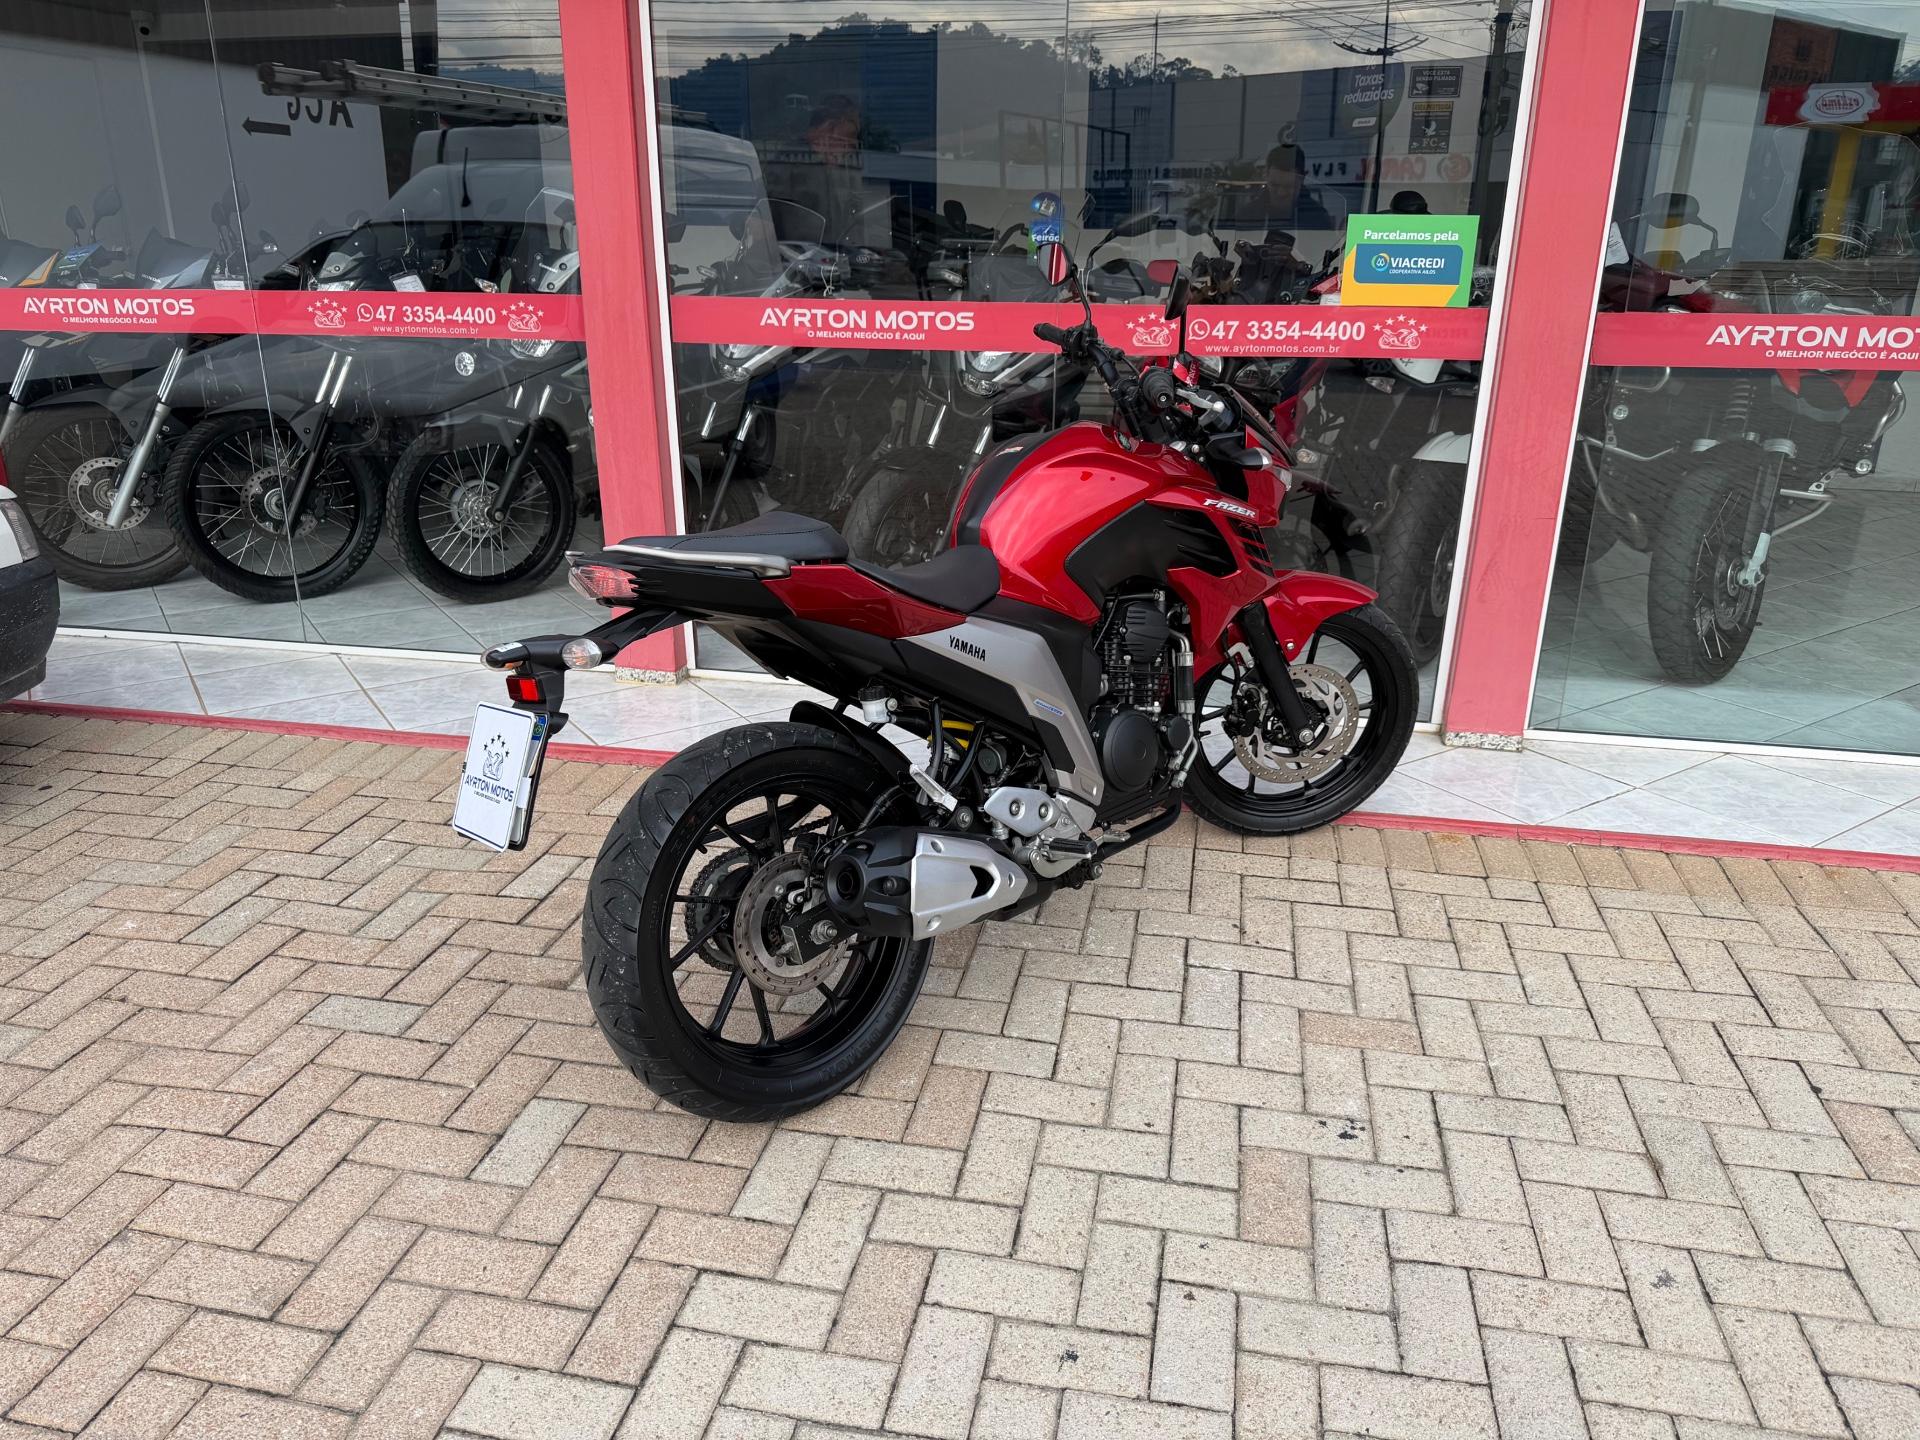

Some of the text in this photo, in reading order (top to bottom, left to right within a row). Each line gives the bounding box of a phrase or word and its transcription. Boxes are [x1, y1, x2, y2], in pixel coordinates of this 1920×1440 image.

[1354, 73, 1385, 87] Taxas
[1343, 87, 1395, 104] reduzidas
[1363, 229, 1459, 242] Parcelamos pela
[1390, 257, 1445, 269] VIACREDI
[23, 296, 195, 316] AYRTON MOTOS
[139, 317, 158, 325] AQUI
[375, 305, 496, 325] 47 3354-4400
[759, 307, 975, 331] AYRTON MOTOS
[373, 325, 479, 335] www.ayrtonmotos.com.br
[816, 330, 852, 338] MELHOR
[853, 330, 893, 339] NEGÓCIO
[895, 331, 901, 340] É
[902, 332, 925, 340] AQUI
[1212, 320, 1365, 341] 47 3354-4400
[1706, 325, 1920, 348] AYRTON MO
[1205, 343, 1340, 355] www.ayrtonmotos.com.br
[1765, 349, 1920, 361] O MELHOR NEGÓCIO É AQUI
[1203, 498, 1256, 518] FAZER
[949, 635, 986, 662] YAMAHA
[464, 774, 490, 793] AYRTON
[491, 783, 514, 802] MOTOS
